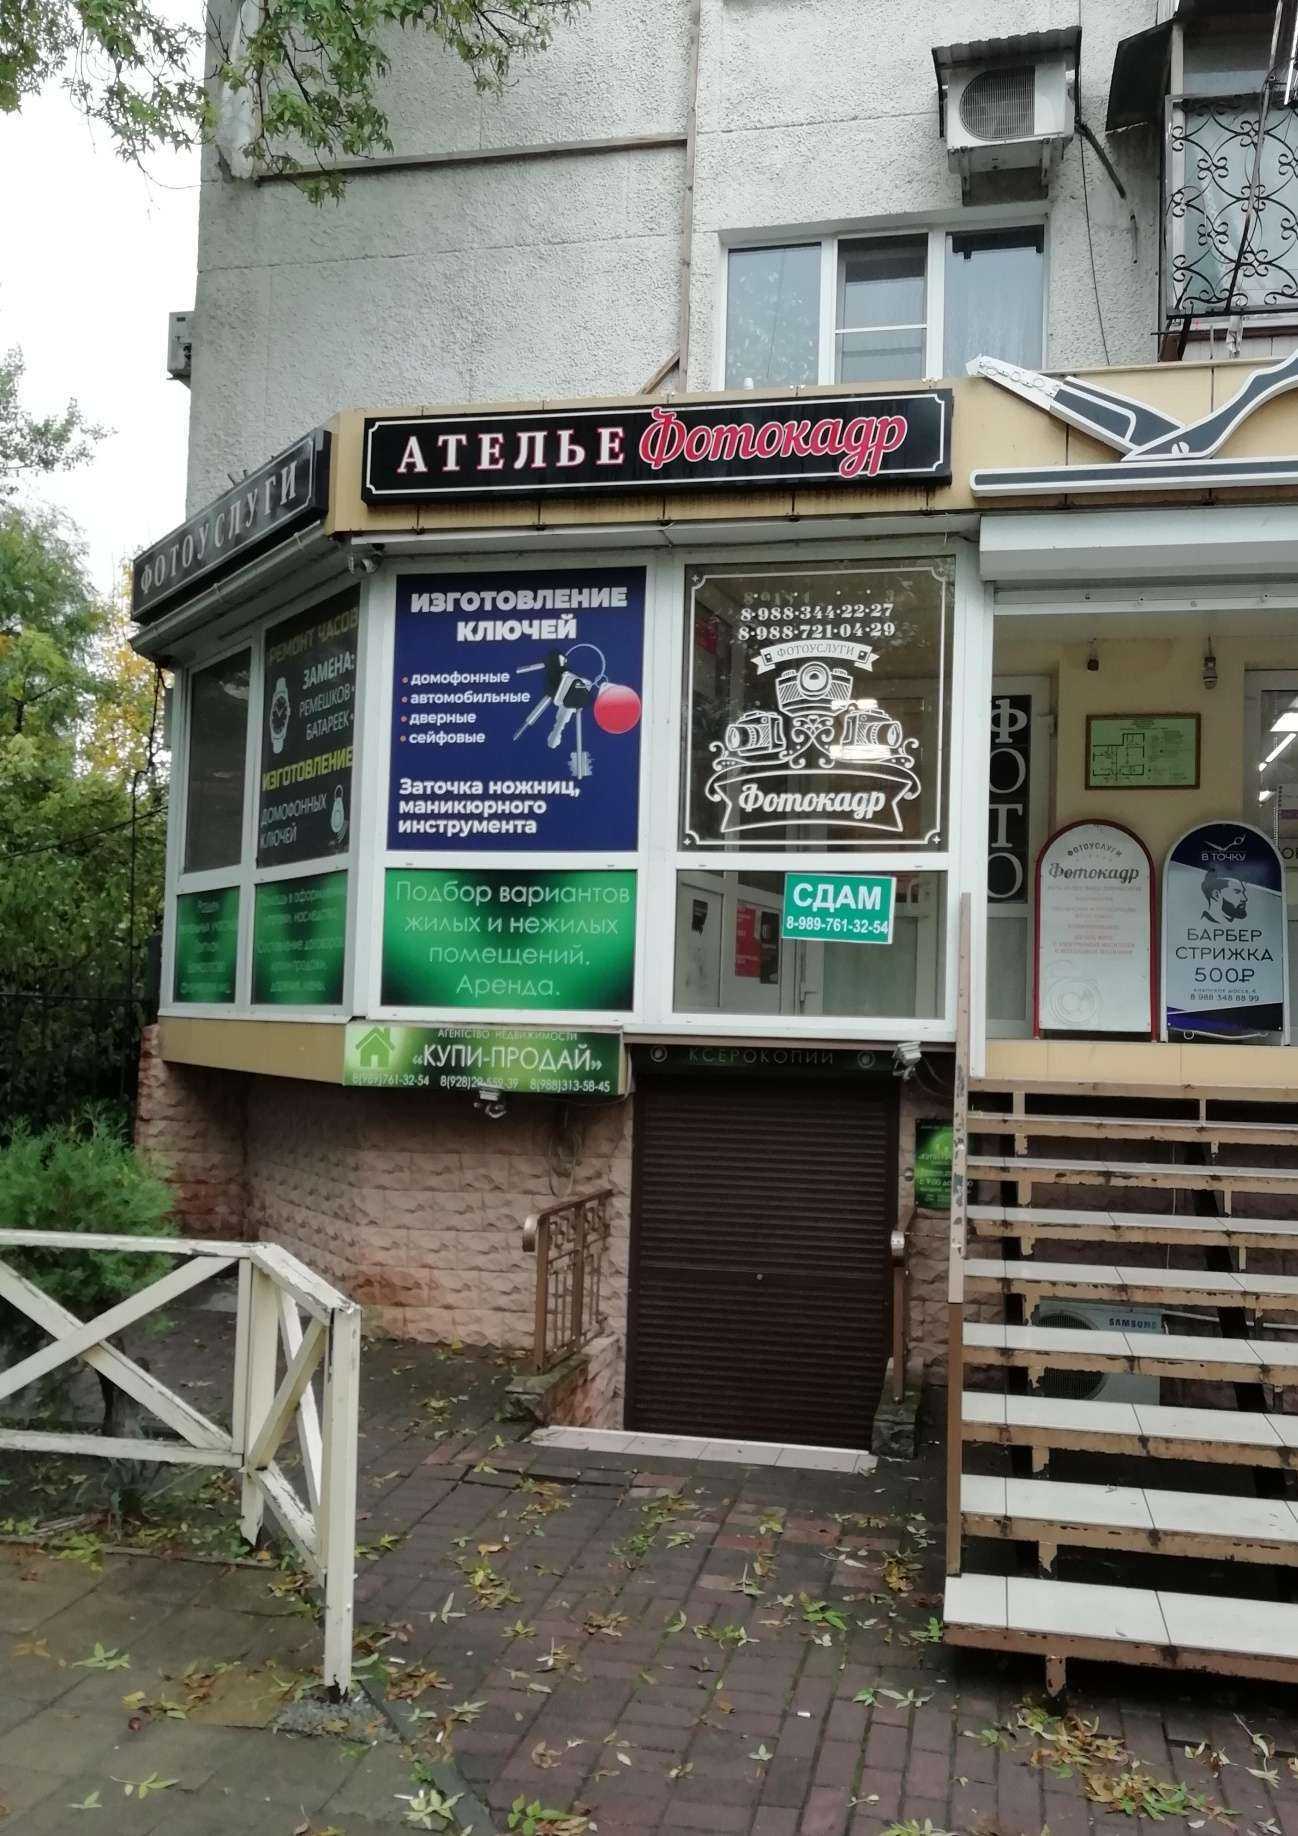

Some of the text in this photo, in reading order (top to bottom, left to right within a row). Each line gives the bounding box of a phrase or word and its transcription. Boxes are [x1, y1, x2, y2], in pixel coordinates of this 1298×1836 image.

[397, 406, 908, 479] АТЕЛЬЕ Фотокадр
[140, 461, 298, 594] ФОТОУСЛУГИ
[410, 586, 628, 613] ИЗГОТОВЛЕНИЕ
[457, 613, 577, 642] КЛЮЧЕЙ
[776, 643, 856, 658] ФОТОУСЛУГИ
[302, 651, 356, 691] ЗАМЕНА:
[410, 671, 511, 686] домофонные
[299, 683, 351, 717] РЕМЕШКОВ
[410, 691, 531, 705] автомобильные
[306, 710, 350, 741] БАТАРЕЕК
[409, 712, 477, 727] дверные
[409, 731, 486, 746] сейфовые
[262, 745, 353, 792] ИЗГОТОВЛЕНИЕ
[399, 778, 581, 798] Заточка ножниц,
[987, 698, 1027, 898] ФОТО
[398, 799, 548, 818] маникюрного
[738, 782, 886, 820] Фотокадр
[398, 819, 538, 837] инструмента
[1201, 853, 1247, 862] В ТОЧКУ
[1048, 863, 1140, 884] Фотокадр
[396, 880, 631, 907] Подбор вариантов
[792, 883, 882, 913] СДАМ
[404, 916, 619, 934] жилых и нежилых
[786, 916, 889, 935] 8-989-761-32-54
[1187, 928, 1262, 943] БАРБЕР
[429, 944, 591, 966] помещений.
[1176, 946, 1274, 962] СТРИЖКА
[456, 975, 561, 998] Аренда.
[438, 1029, 490, 1040] АГЕНТСТВО
[688, 1048, 834, 1065] КСЕРОКОПИИ
[1109, 1317, 1157, 1330] SAMSUNG
